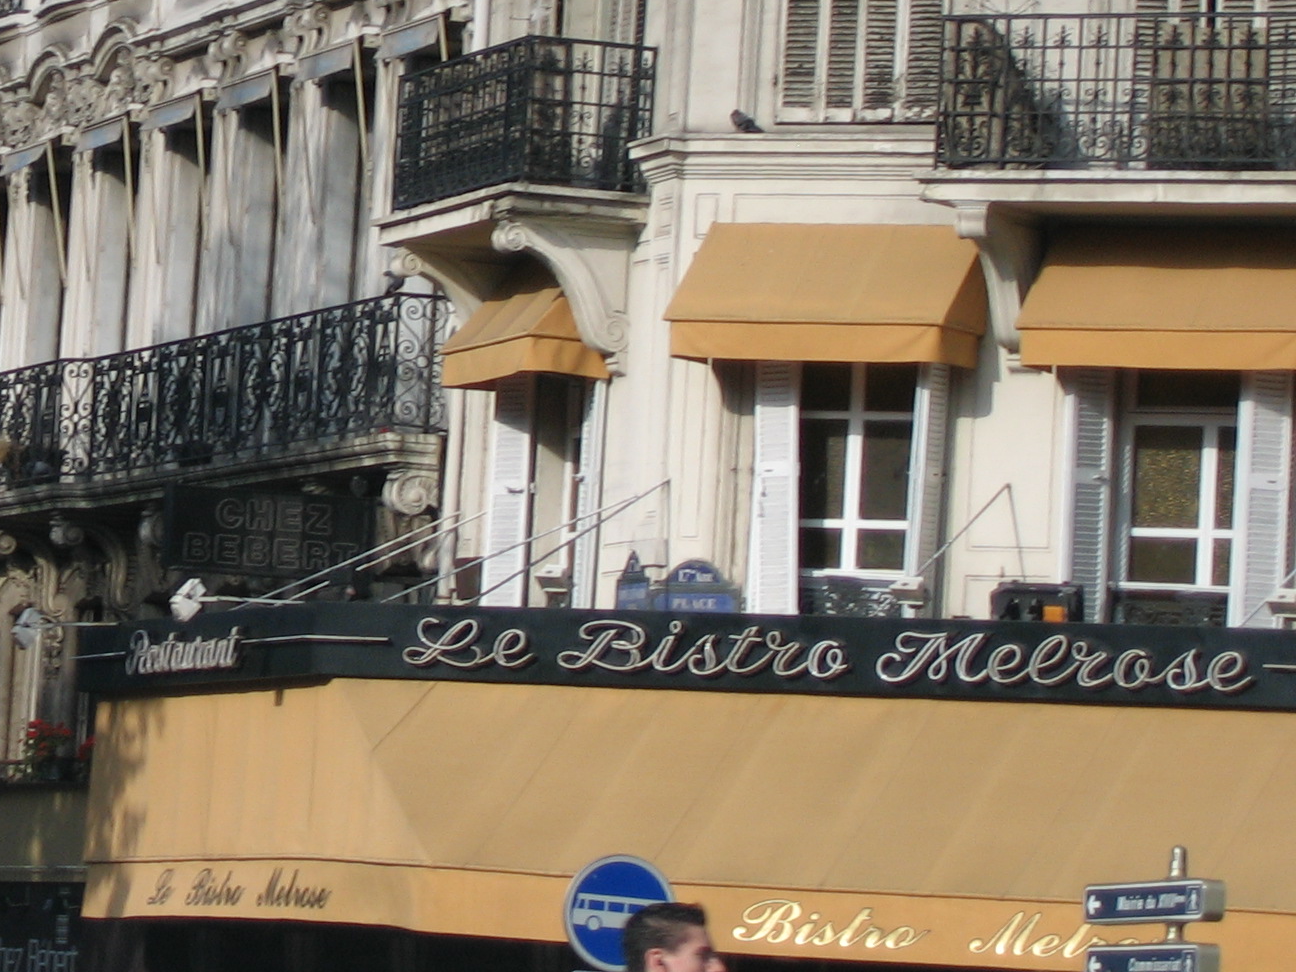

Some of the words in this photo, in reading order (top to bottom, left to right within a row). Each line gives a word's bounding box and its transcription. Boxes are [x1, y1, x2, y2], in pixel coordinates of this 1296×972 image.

[215, 497, 333, 535] CHEZ
[182, 531, 360, 571] BEBERT
[671, 597, 718, 610] PLACE
[125, 625, 242, 676] Restaurant
[402, 617, 536, 668] Le
[556, 619, 850, 680] Bistro
[875, 630, 1255, 691] Melrose
[146, 868, 173, 906] Le
[185, 867, 245, 907] Bistro
[256, 867, 332, 910] Melrose
[732, 899, 932, 949] Bistro
